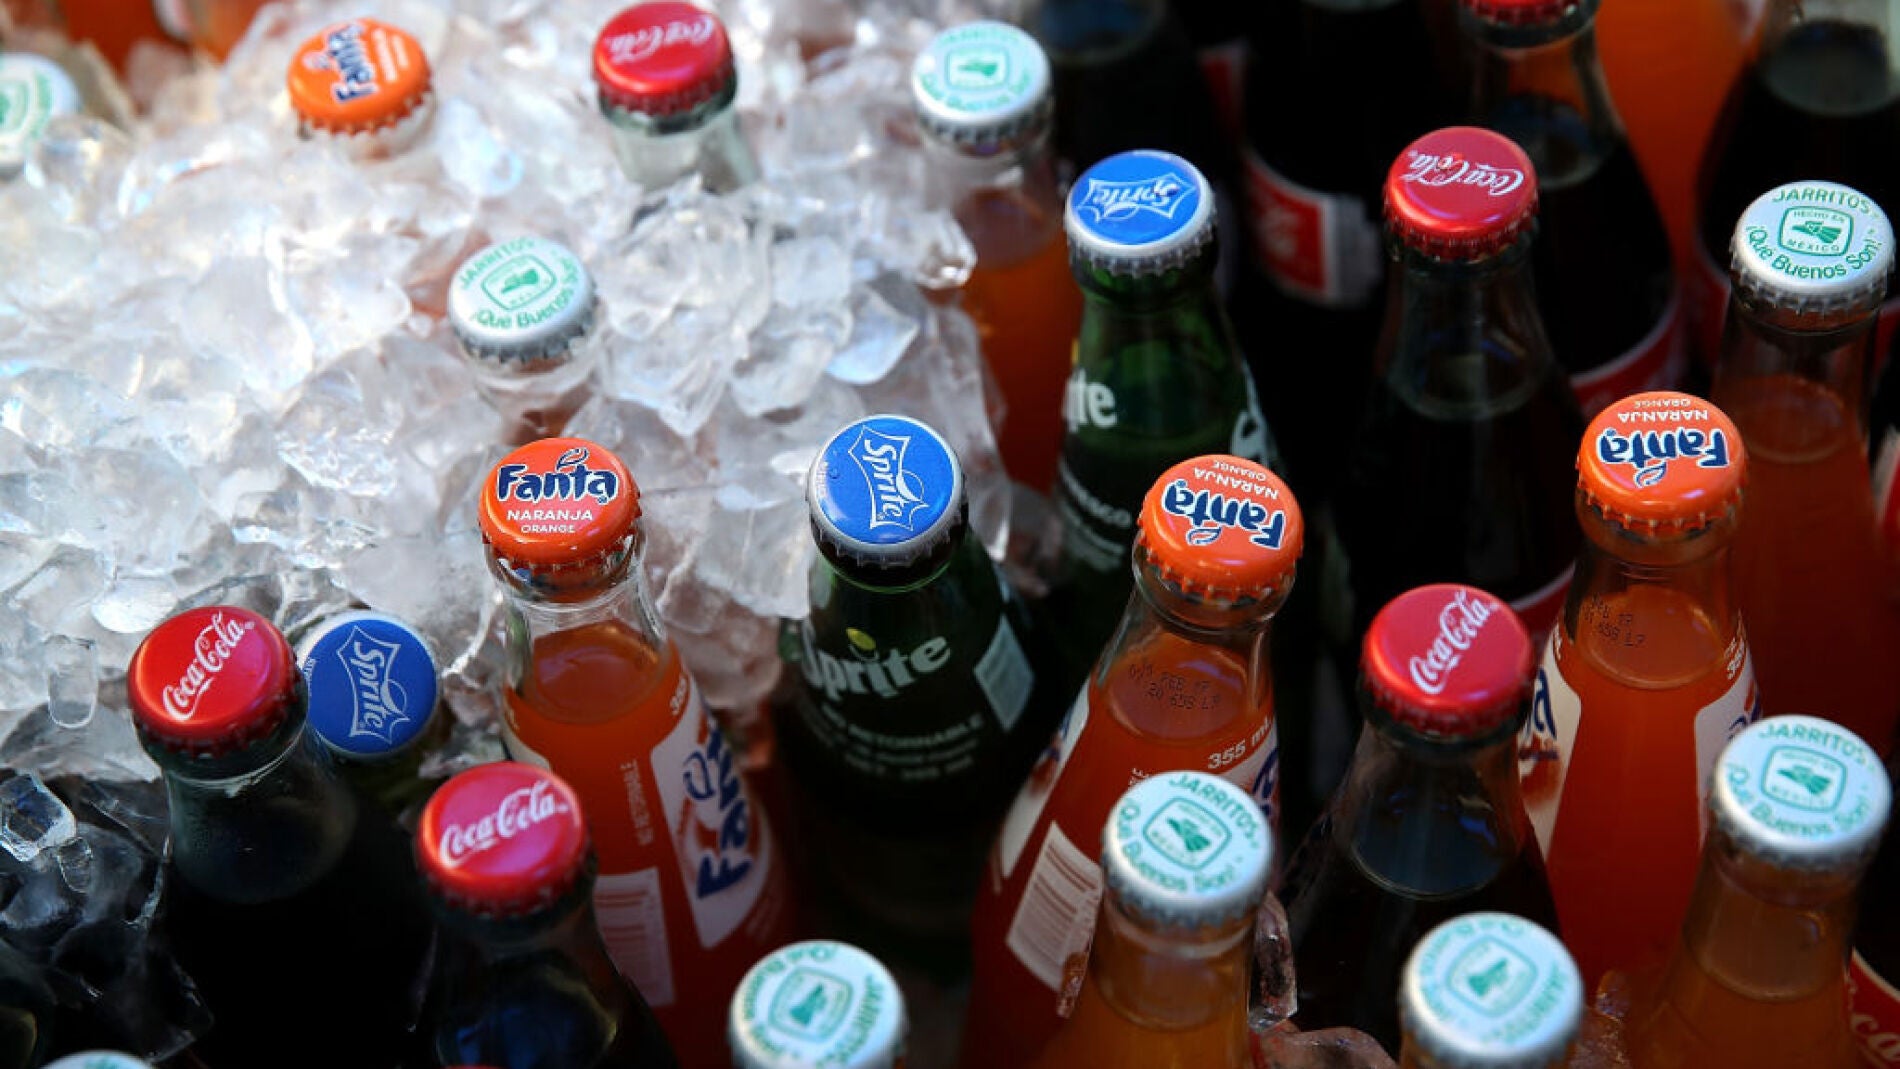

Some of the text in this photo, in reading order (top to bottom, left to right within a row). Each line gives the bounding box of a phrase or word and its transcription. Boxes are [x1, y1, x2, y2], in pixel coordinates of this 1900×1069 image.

[1092, 178, 1180, 208] Sprite
[1772, 187, 1871, 214] JARRITOS
[1772, 253, 1847, 280] Buenos
[1617, 409, 1708, 424] NARANJA
[1596, 427, 1729, 469] Fanta
[497, 463, 620, 504] Fanta
[862, 439, 902, 517] Sprite
[1194, 467, 1279, 500] NARANJA
[1213, 460, 1267, 482] ORANGE
[506, 509, 593, 521] NARANJA
[521, 524, 576, 534] ORANGE
[1161, 480, 1287, 550] Fanta
[350, 641, 385, 729] Sprite
[1207, 739, 1246, 769] 355
[1758, 723, 1866, 765] JARRITOS
[1169, 774, 1258, 839] JARRITOS
